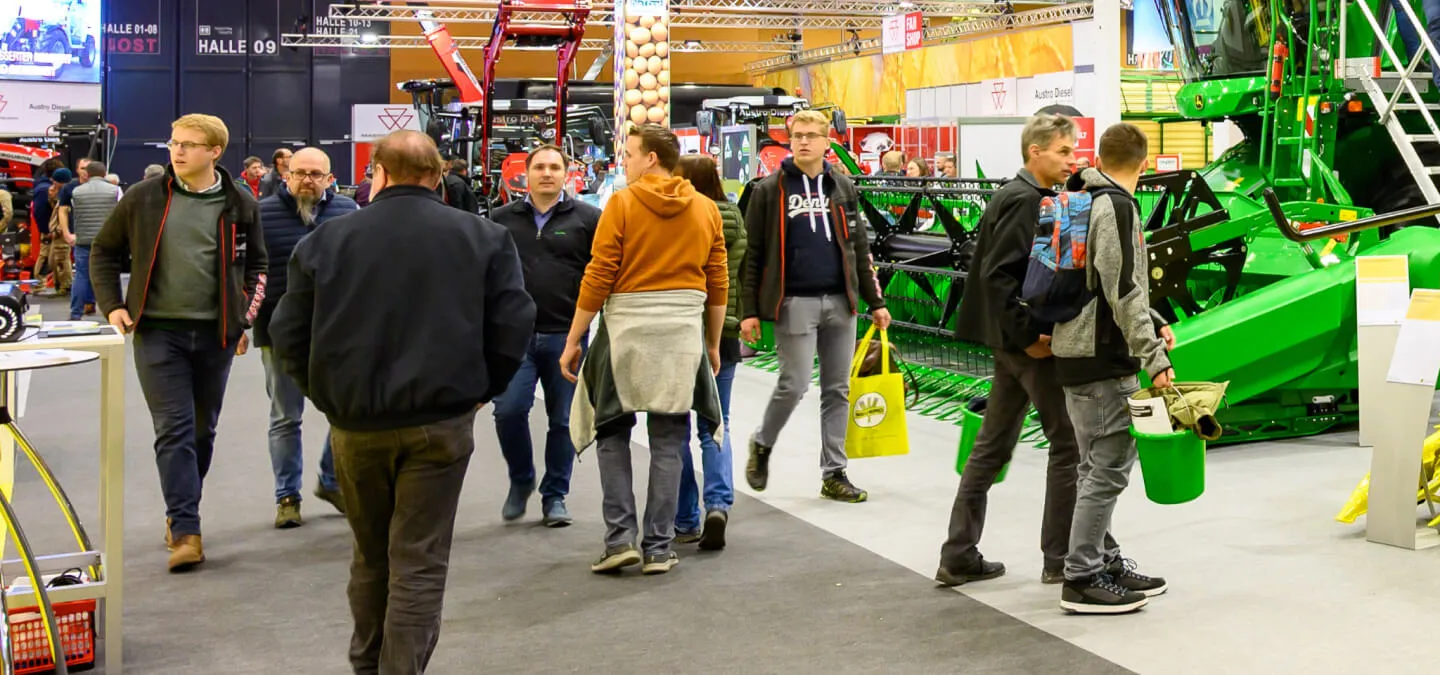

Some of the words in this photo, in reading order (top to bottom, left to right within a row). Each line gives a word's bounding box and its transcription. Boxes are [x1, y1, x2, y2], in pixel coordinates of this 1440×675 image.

[316, 16, 346, 27] HALLE
[101, 24, 132, 35] HALLE
[134, 24, 158, 35] 01-08
[906, 31, 921, 46] SHOP
[199, 39, 247, 54] HALLE
[253, 39, 276, 54] 09
[1035, 89, 1053, 99] Austro
[1055, 87, 1073, 98] Diesel
[739, 108, 768, 118] Austro
